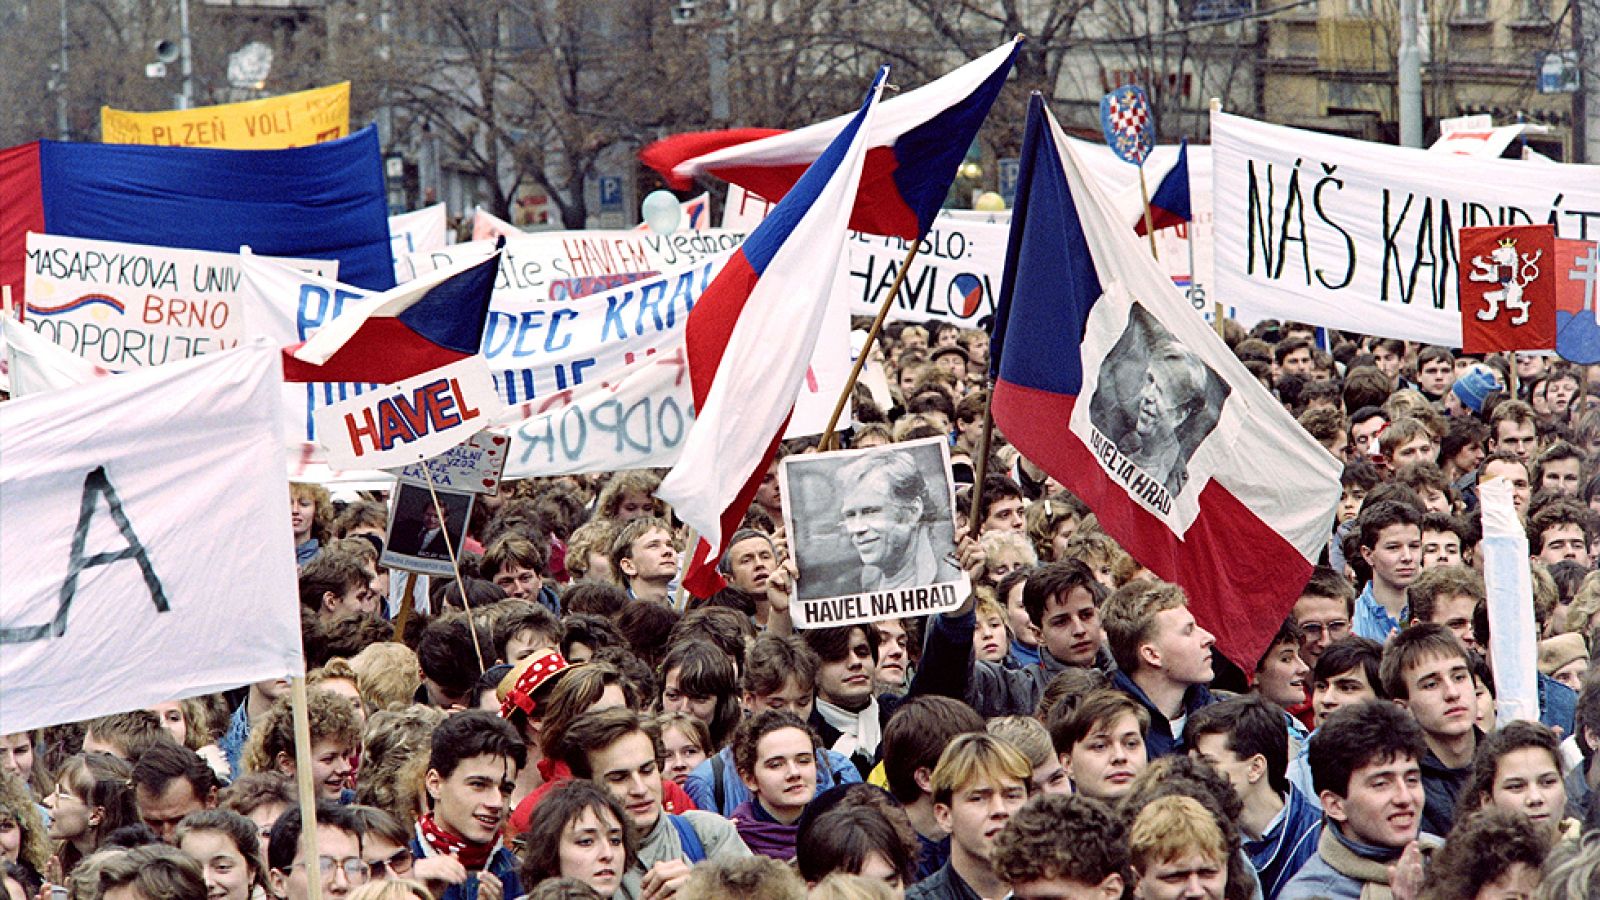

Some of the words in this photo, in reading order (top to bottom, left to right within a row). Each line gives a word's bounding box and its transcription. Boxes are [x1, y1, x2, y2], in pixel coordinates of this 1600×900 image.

[152, 116, 226, 147] PLZEŇ
[244, 107, 293, 138] VOLÍ
[604, 179, 617, 200] P
[1247, 157, 1356, 290] NÁŠ
[884, 229, 974, 261] SLO:
[26, 247, 179, 292] MASARYKOVA
[143, 295, 229, 330] BRNO
[483, 308, 579, 360] DEC
[344, 378, 480, 457] HAVEL
[804, 598, 868, 623] HAVEL
[869, 592, 899, 617] NA
[900, 584, 957, 612] HRAD
